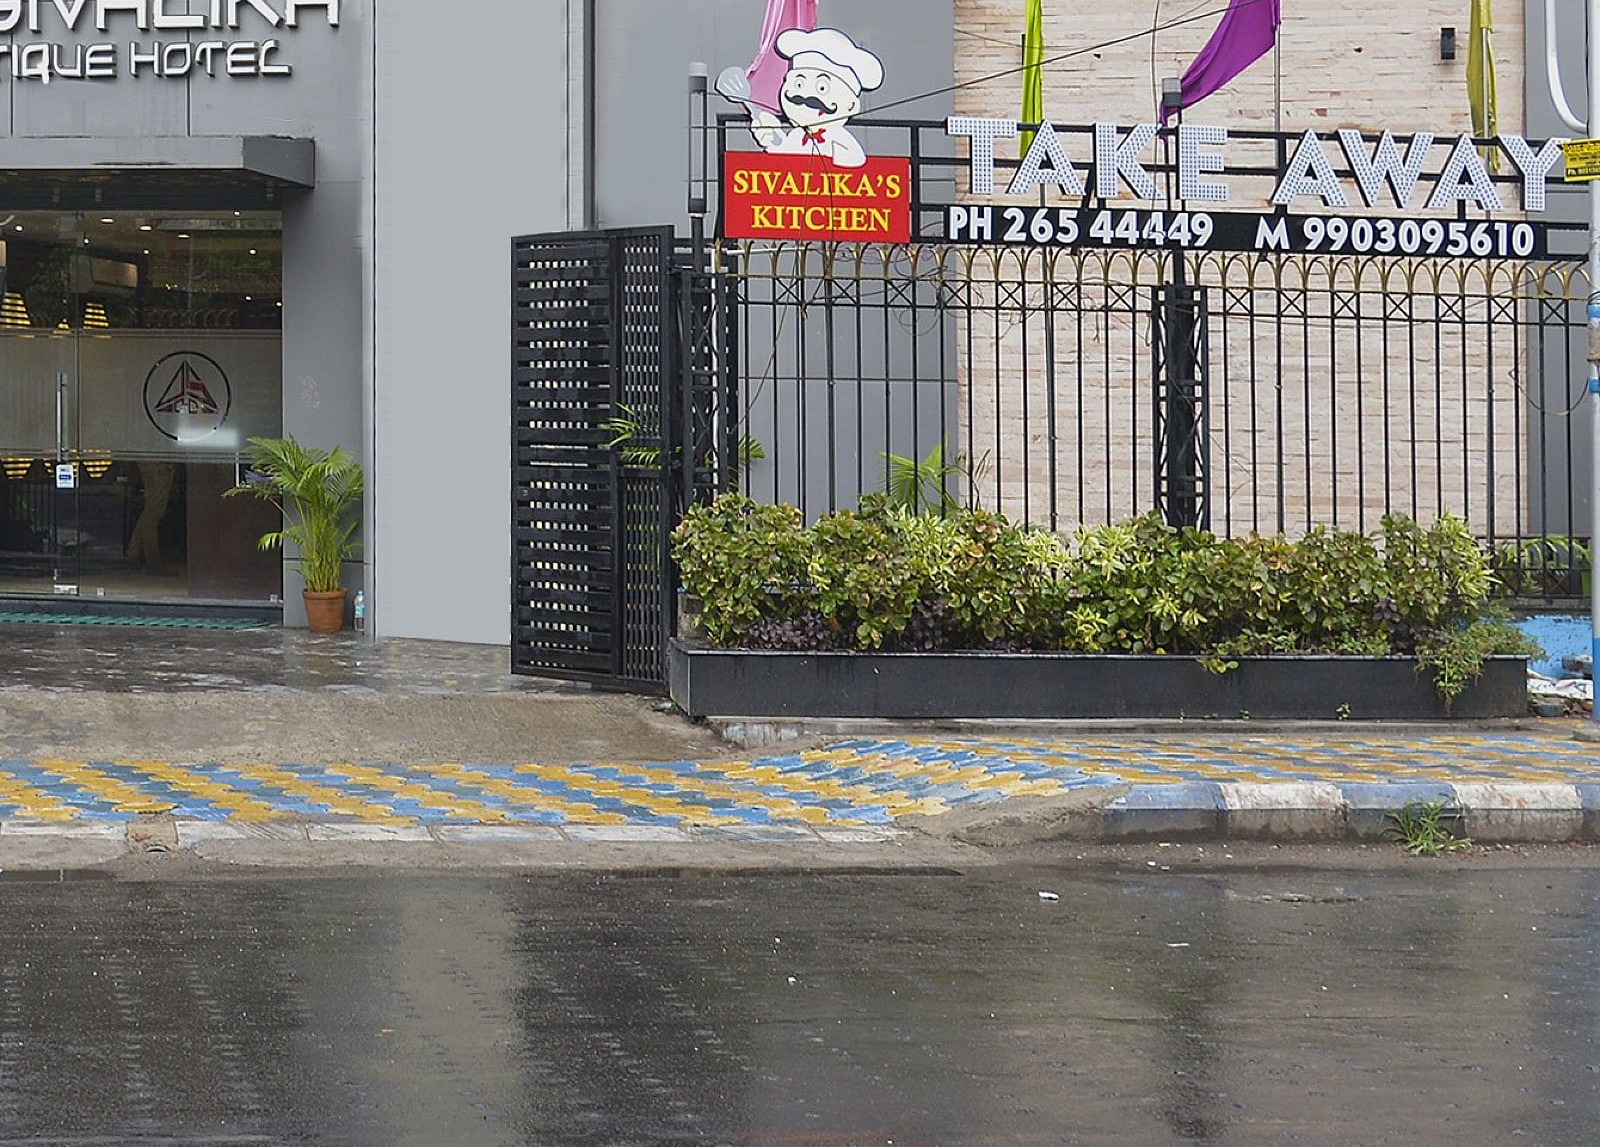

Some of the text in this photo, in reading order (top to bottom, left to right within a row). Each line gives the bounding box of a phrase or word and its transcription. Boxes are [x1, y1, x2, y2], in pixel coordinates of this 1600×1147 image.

[129, 39, 292, 77] HOTEL
[947, 115, 1572, 212] TAKE AWAY
[733, 169, 901, 199] SIVALIKA'S
[751, 205, 891, 232] KITCHEN
[949, 206, 1535, 256] PH 265 44449 M 9903095610
